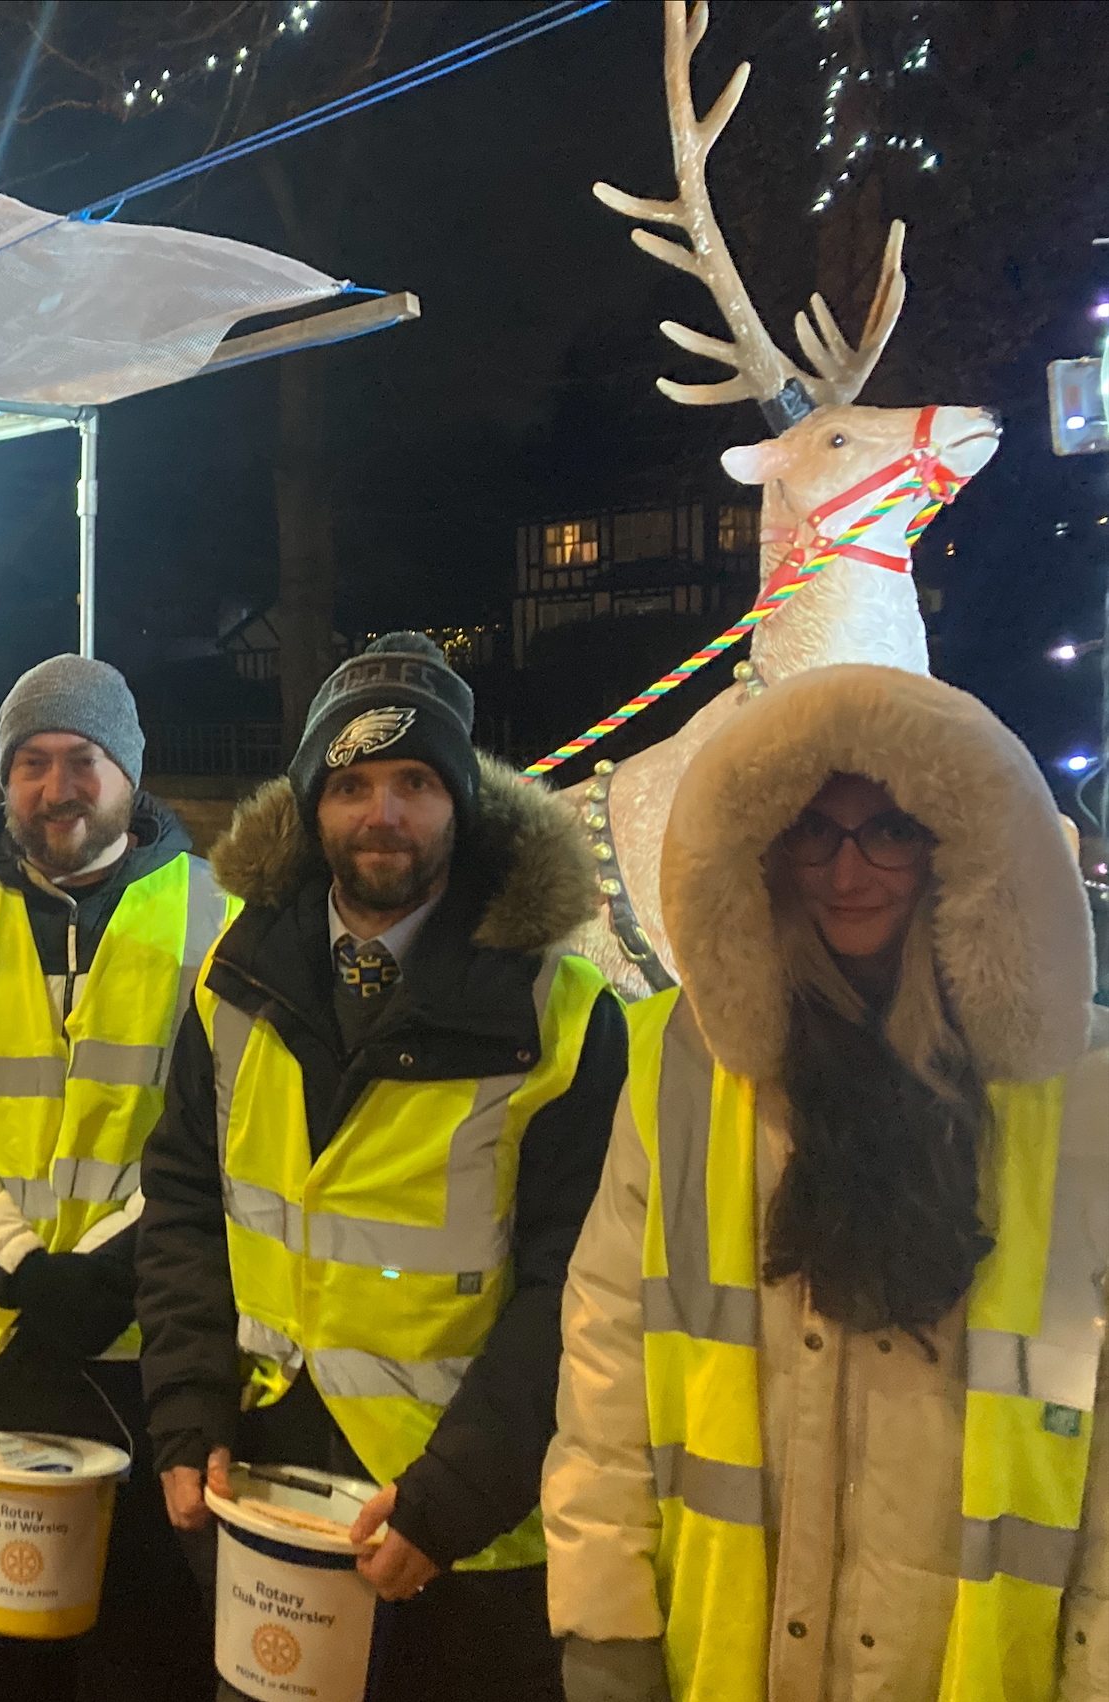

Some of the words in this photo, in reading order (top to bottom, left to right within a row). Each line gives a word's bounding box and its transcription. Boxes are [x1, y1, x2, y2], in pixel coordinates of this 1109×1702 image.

[0, 1503, 44, 1521] Rotary
[5, 1519, 17, 1531] of
[20, 1520, 70, 1535] Worsley
[256, 1580, 304, 1608] Rotary
[232, 1585, 256, 1608] Club
[259, 1601, 274, 1614] of
[277, 1605, 335, 1629] Worsley
